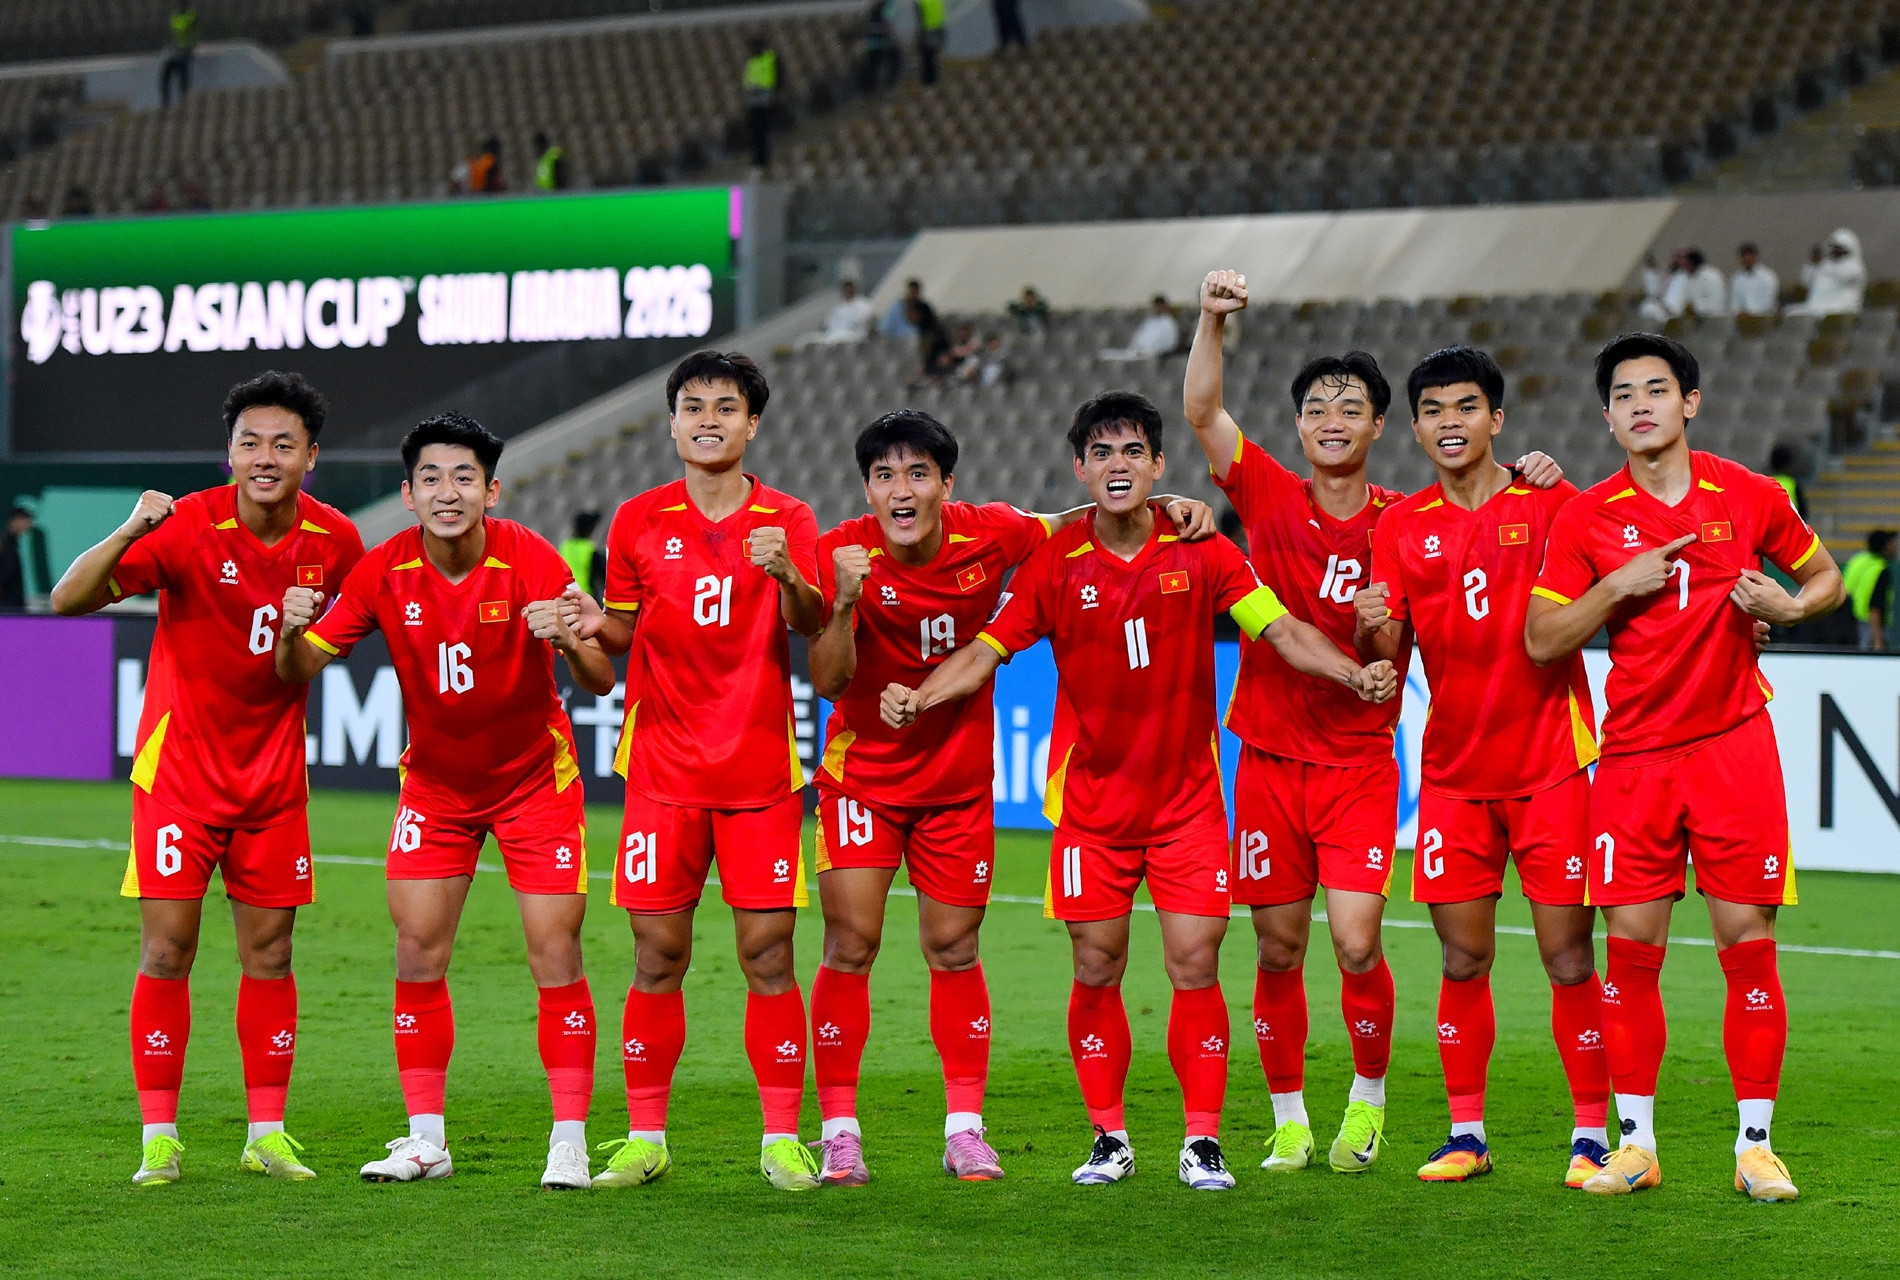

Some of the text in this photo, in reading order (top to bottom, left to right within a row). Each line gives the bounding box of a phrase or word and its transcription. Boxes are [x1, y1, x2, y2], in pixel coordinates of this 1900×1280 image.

[81, 286, 164, 355] U23
[164, 282, 304, 352] ASIAN
[303, 277, 406, 349] CUP
[693, 574, 733, 627] 21
[1319, 554, 1362, 604] 12
[1463, 567, 1489, 621] 2
[1668, 557, 1690, 610] 7
[248, 603, 278, 655] 6
[920, 613, 955, 661] 19
[1124, 617, 1150, 670] 11
[438, 641, 475, 694] 16
[390, 805, 426, 853] 16
[837, 796, 874, 847] 19
[156, 823, 182, 877] 6
[624, 830, 657, 885] 21
[1063, 845, 1083, 898] 11
[1239, 829, 1271, 881] 12
[1423, 827, 1445, 879] 2
[1595, 831, 1615, 885] 7
